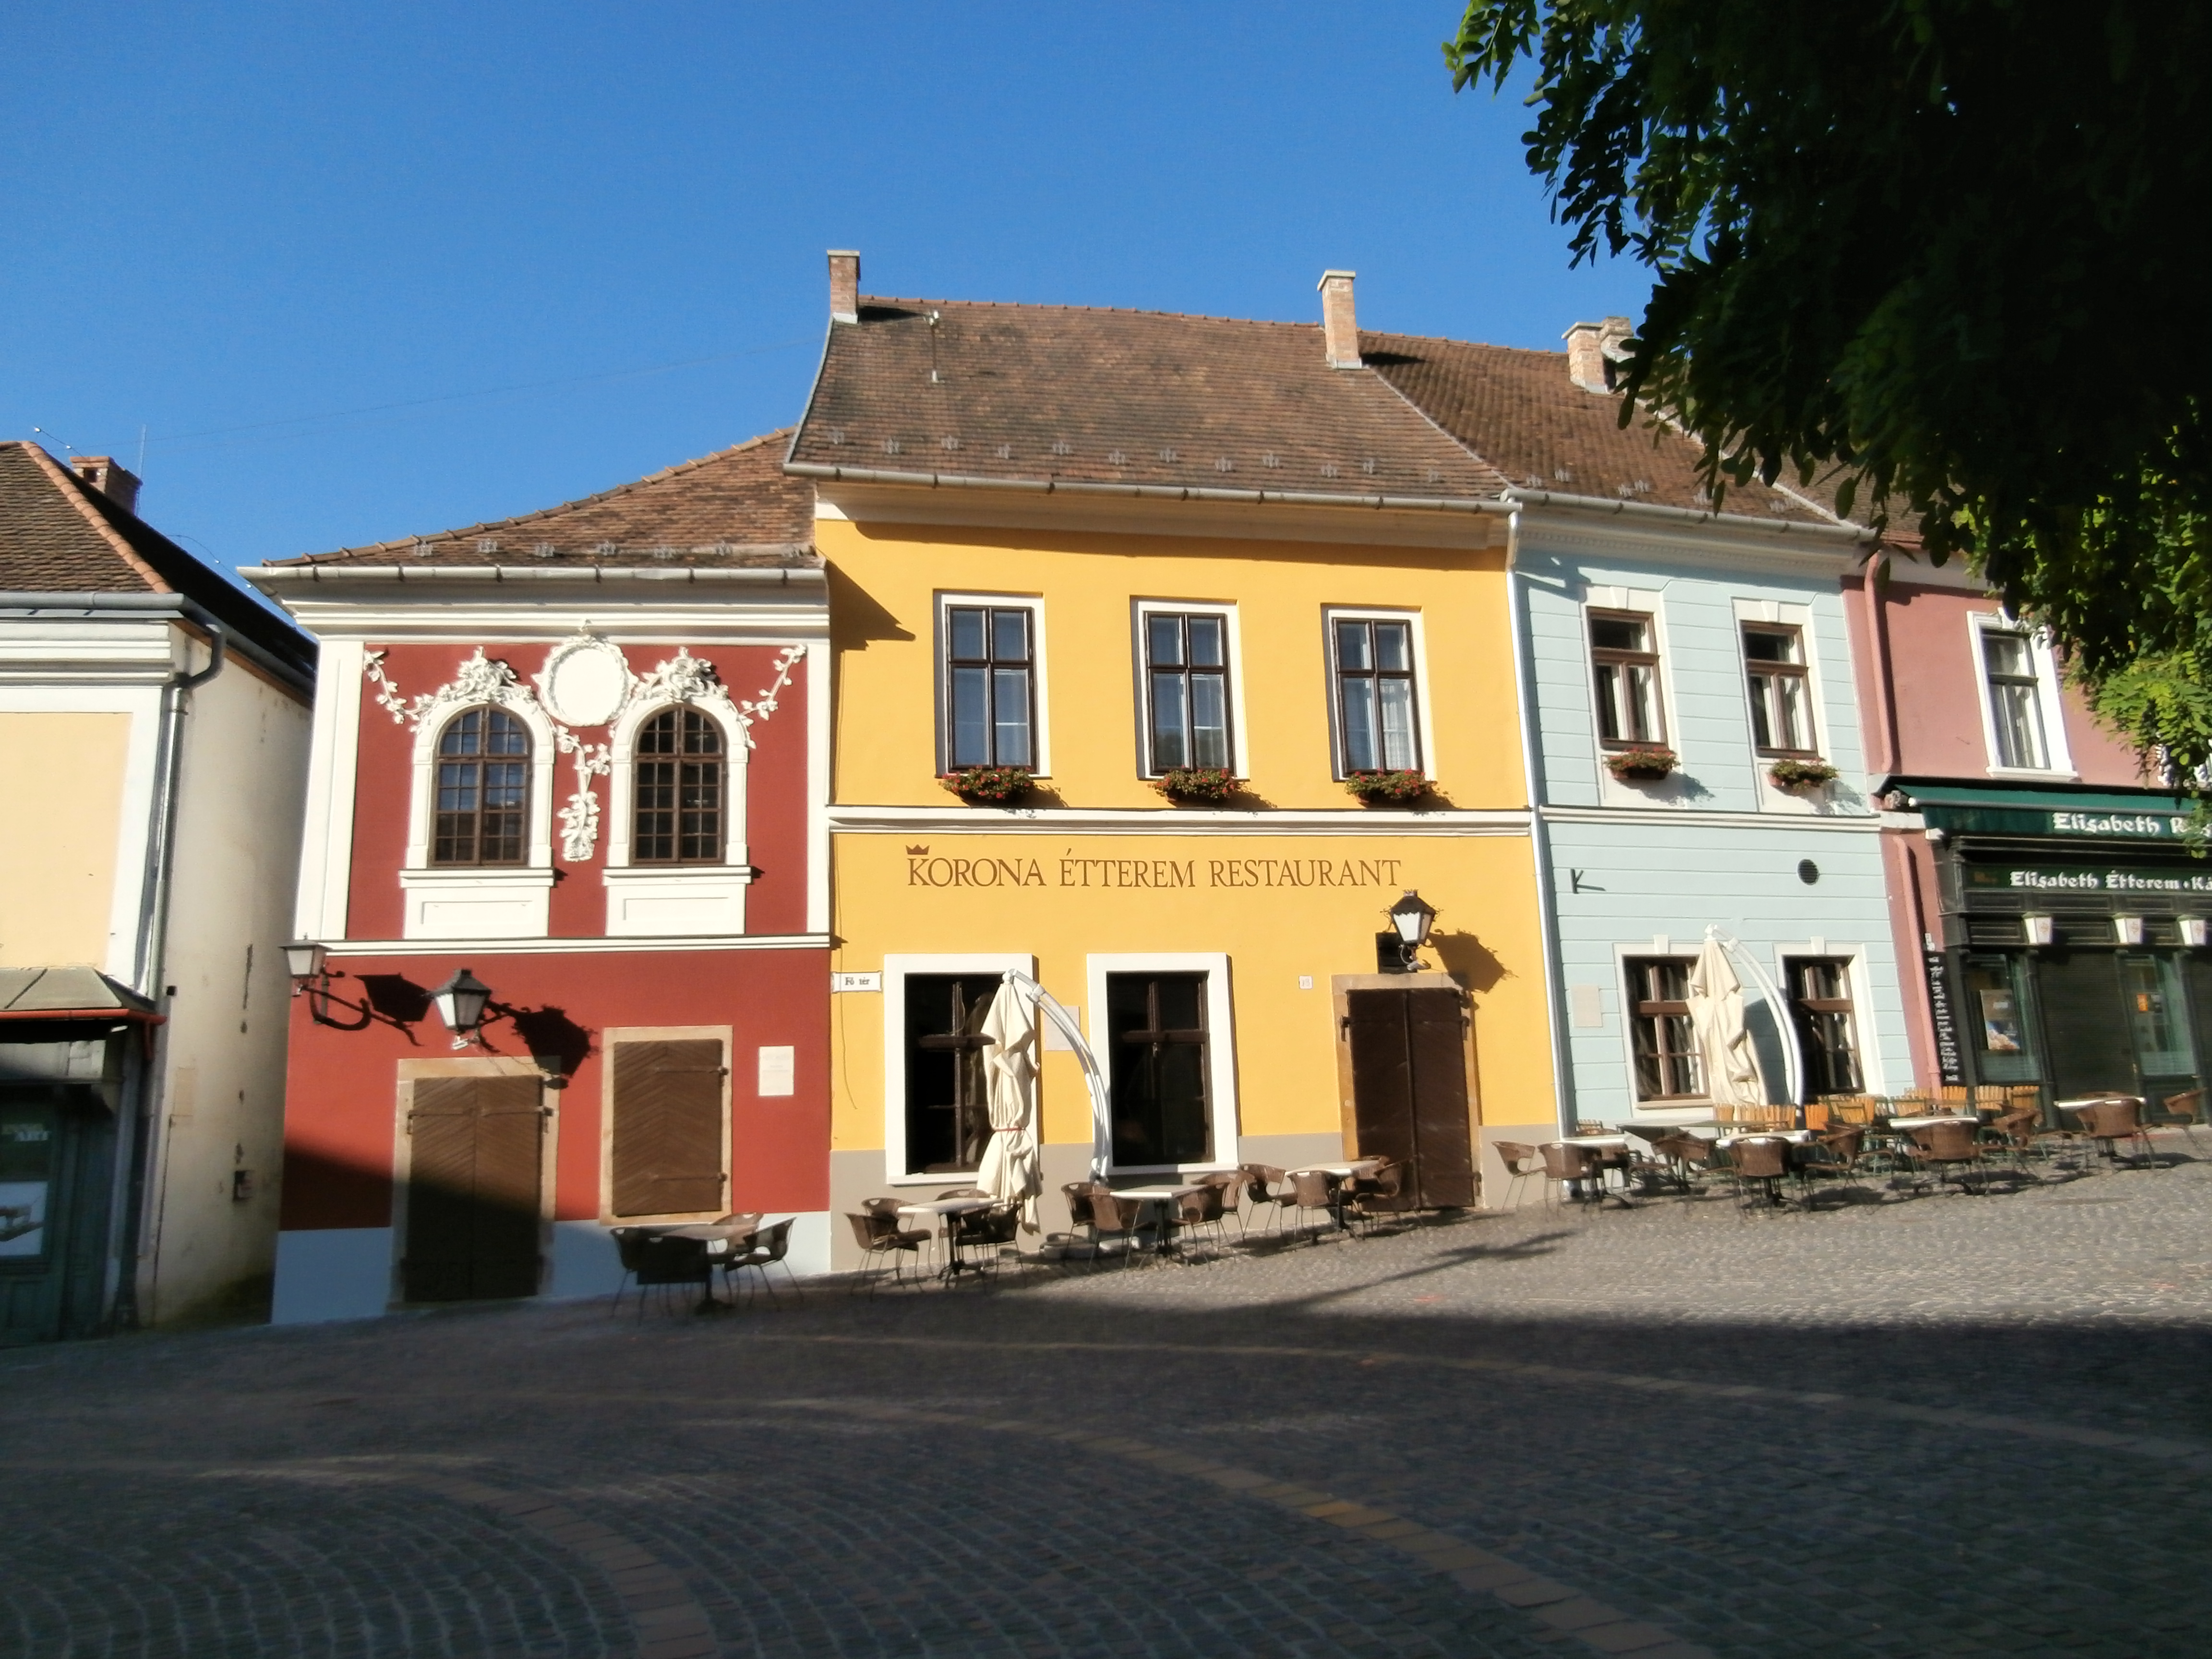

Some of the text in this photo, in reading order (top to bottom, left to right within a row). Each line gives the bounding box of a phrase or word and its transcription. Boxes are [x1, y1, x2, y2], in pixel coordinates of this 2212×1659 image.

[2052, 812, 2160, 836] Elisabeth
[906, 848, 1401, 888] KORONA ÉTTEREM RESTAURANT
[2009, 870, 2098, 889] Elisabeth
[2105, 869, 2179, 890] Étterem
[858, 976, 870, 985] tér
